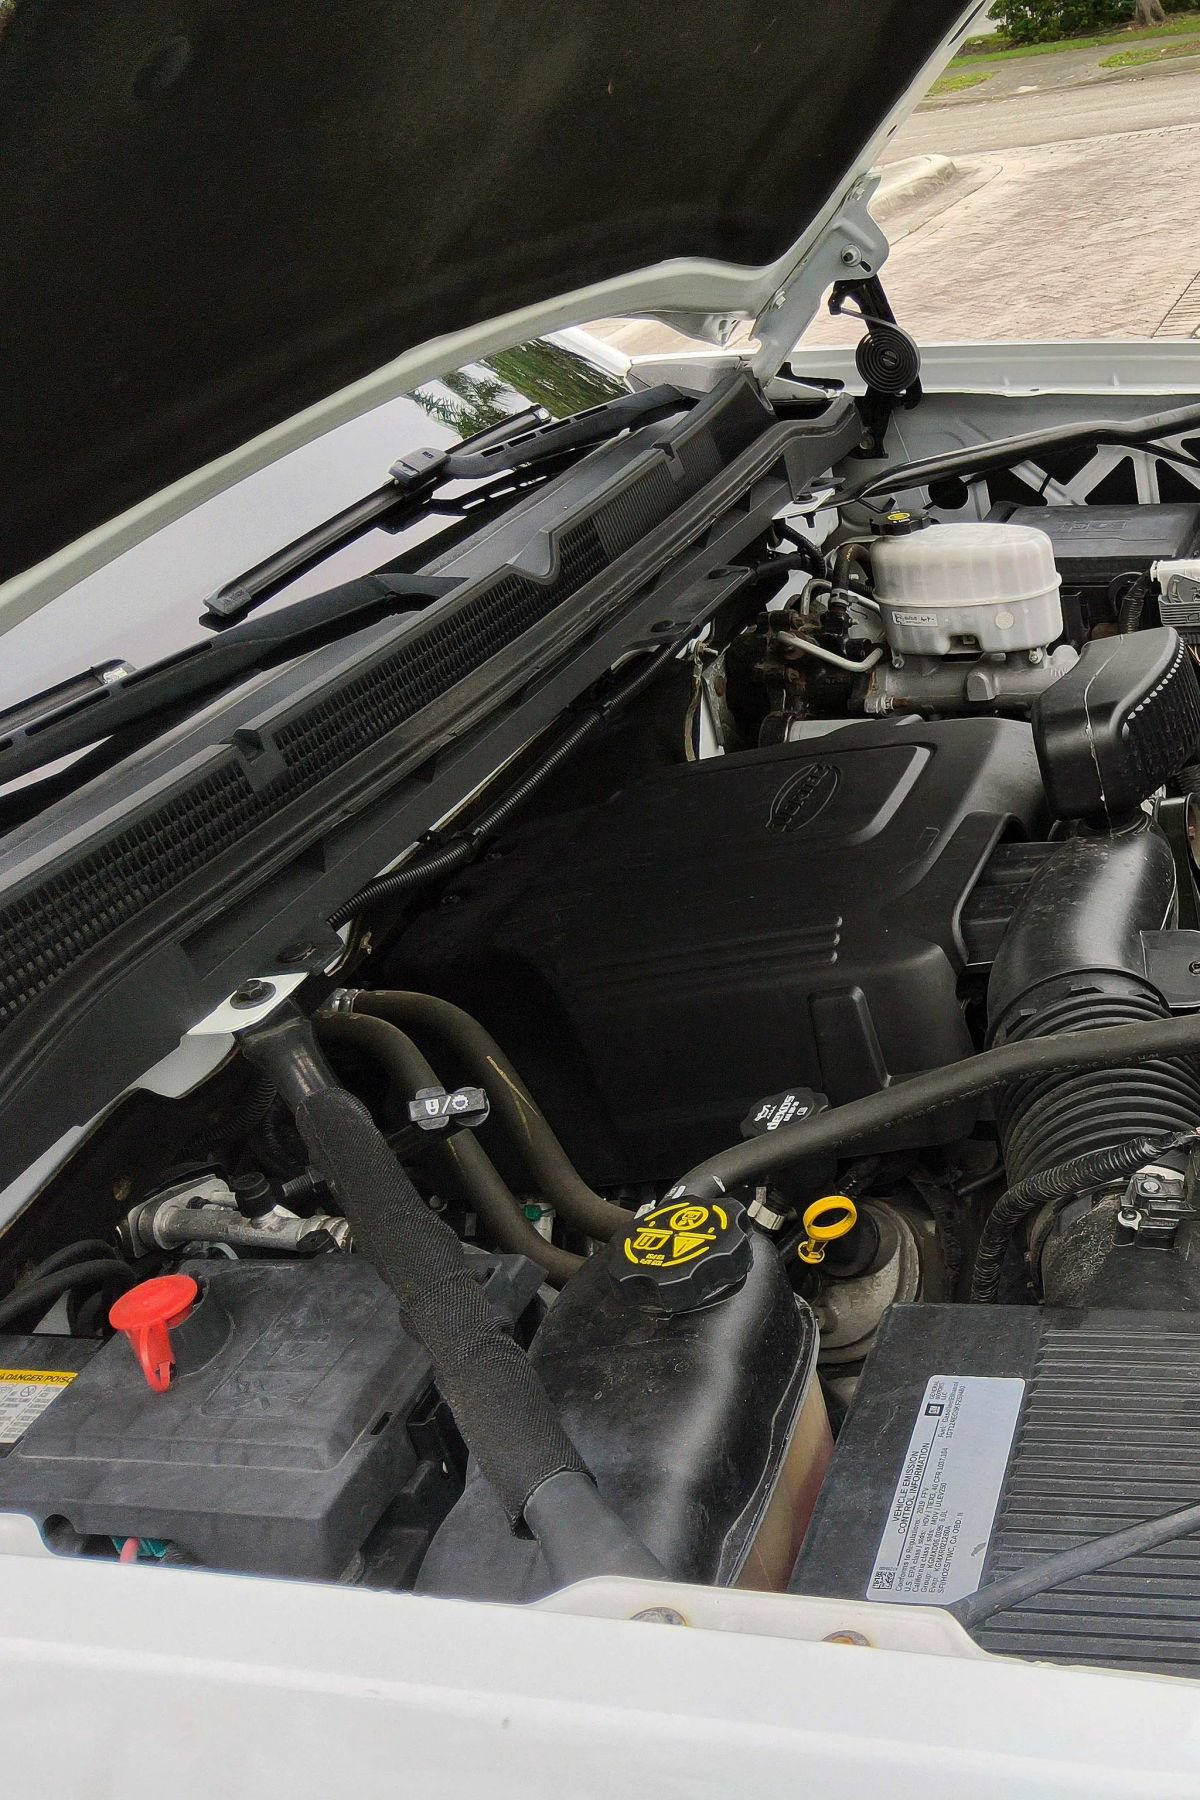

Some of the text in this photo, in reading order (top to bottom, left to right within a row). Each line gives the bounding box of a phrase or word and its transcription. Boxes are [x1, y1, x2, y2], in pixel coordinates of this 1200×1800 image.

[766, 1094, 796, 1130] dexos
[933, 1471, 942, 1483] CFR
[892, 1451, 919, 1521] VEHICLE EMISSION
[898, 1442, 930, 1534] CONTROL INFORMATION
[920, 1487, 929, 1498] FFV
[916, 1500, 925, 1514] 2019
[949, 1535, 958, 1544] CA
[912, 1563, 925, 1592] California
[920, 1546, 929, 1562] class
[930, 1511, 938, 1525] MDV
[912, 1549, 920, 1564] class
[895, 1562, 909, 1591] Conforms
[907, 1566, 916, 1577] EPA
[904, 1580, 913, 1591] U.S.
[920, 1572, 931, 1592] Group:
